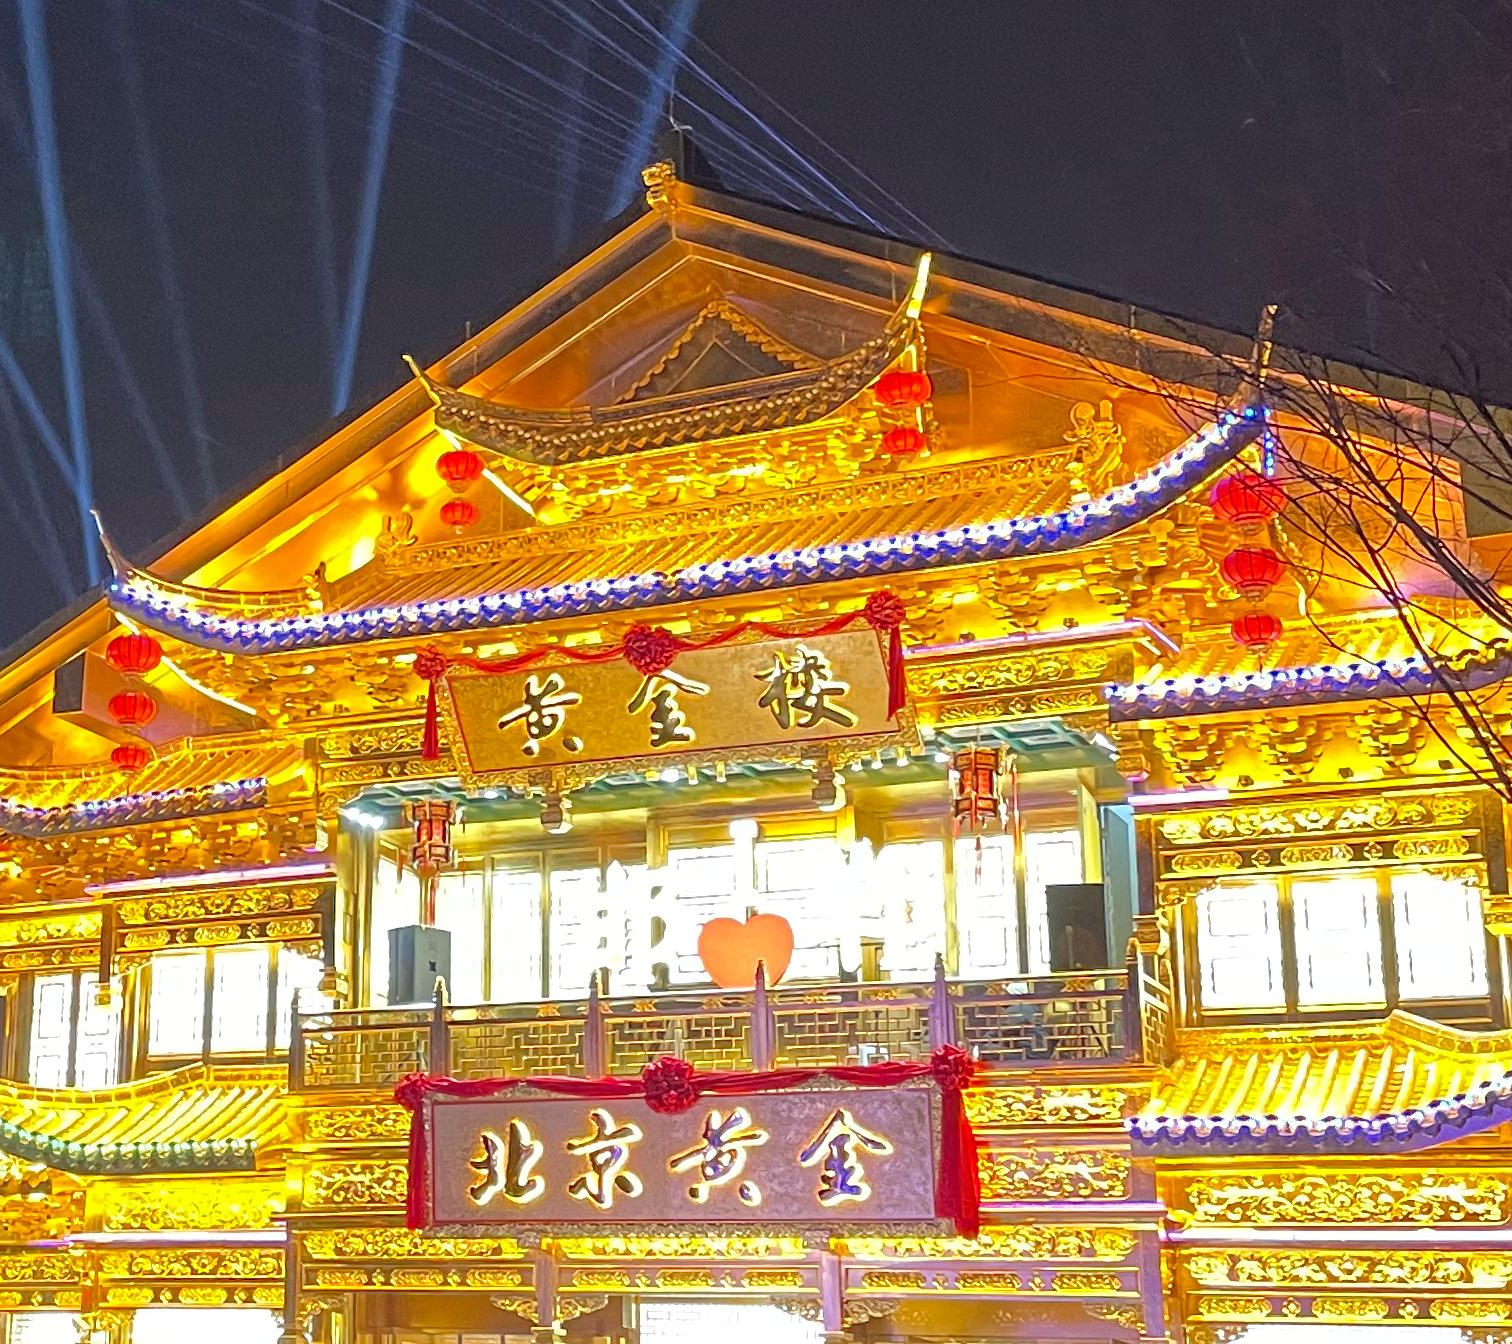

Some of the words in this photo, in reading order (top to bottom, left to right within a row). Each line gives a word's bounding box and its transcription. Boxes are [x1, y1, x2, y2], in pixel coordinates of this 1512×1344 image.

[498, 645, 859, 757] 黄金楼
[468, 1108, 895, 1208] 北京黄金
